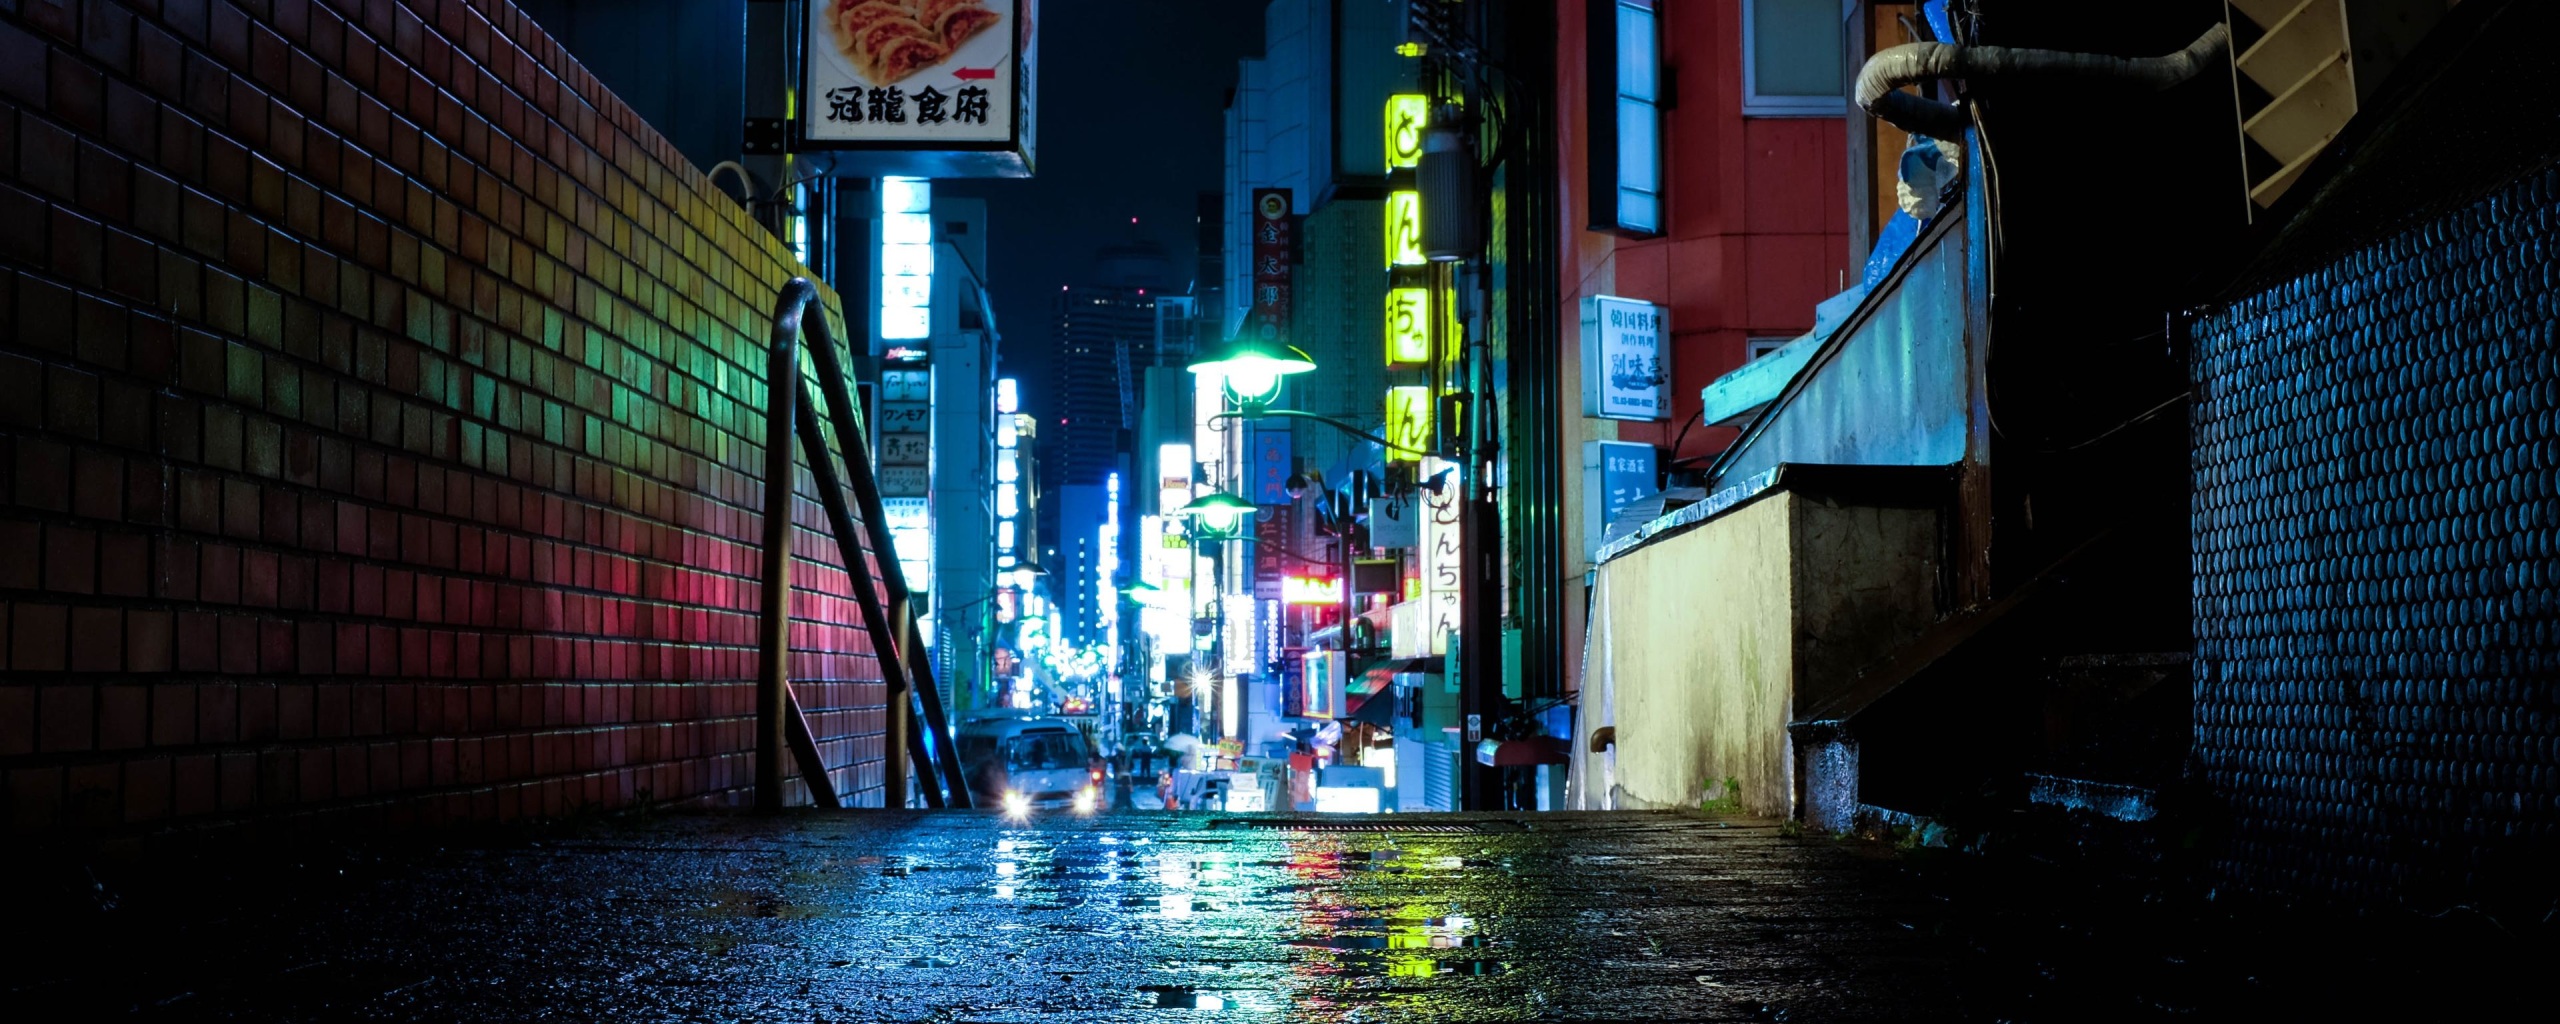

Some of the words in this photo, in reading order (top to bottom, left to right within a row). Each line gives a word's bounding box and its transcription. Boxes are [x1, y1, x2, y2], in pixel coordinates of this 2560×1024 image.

[825, 85, 990, 124] 冠龍食府
[1258, 222, 1280, 307] 金太郎
[1610, 309, 1662, 332] 韓国料理
[884, 409, 926, 421] ワンモア
[1436, 501, 1460, 639] とんちゃん
